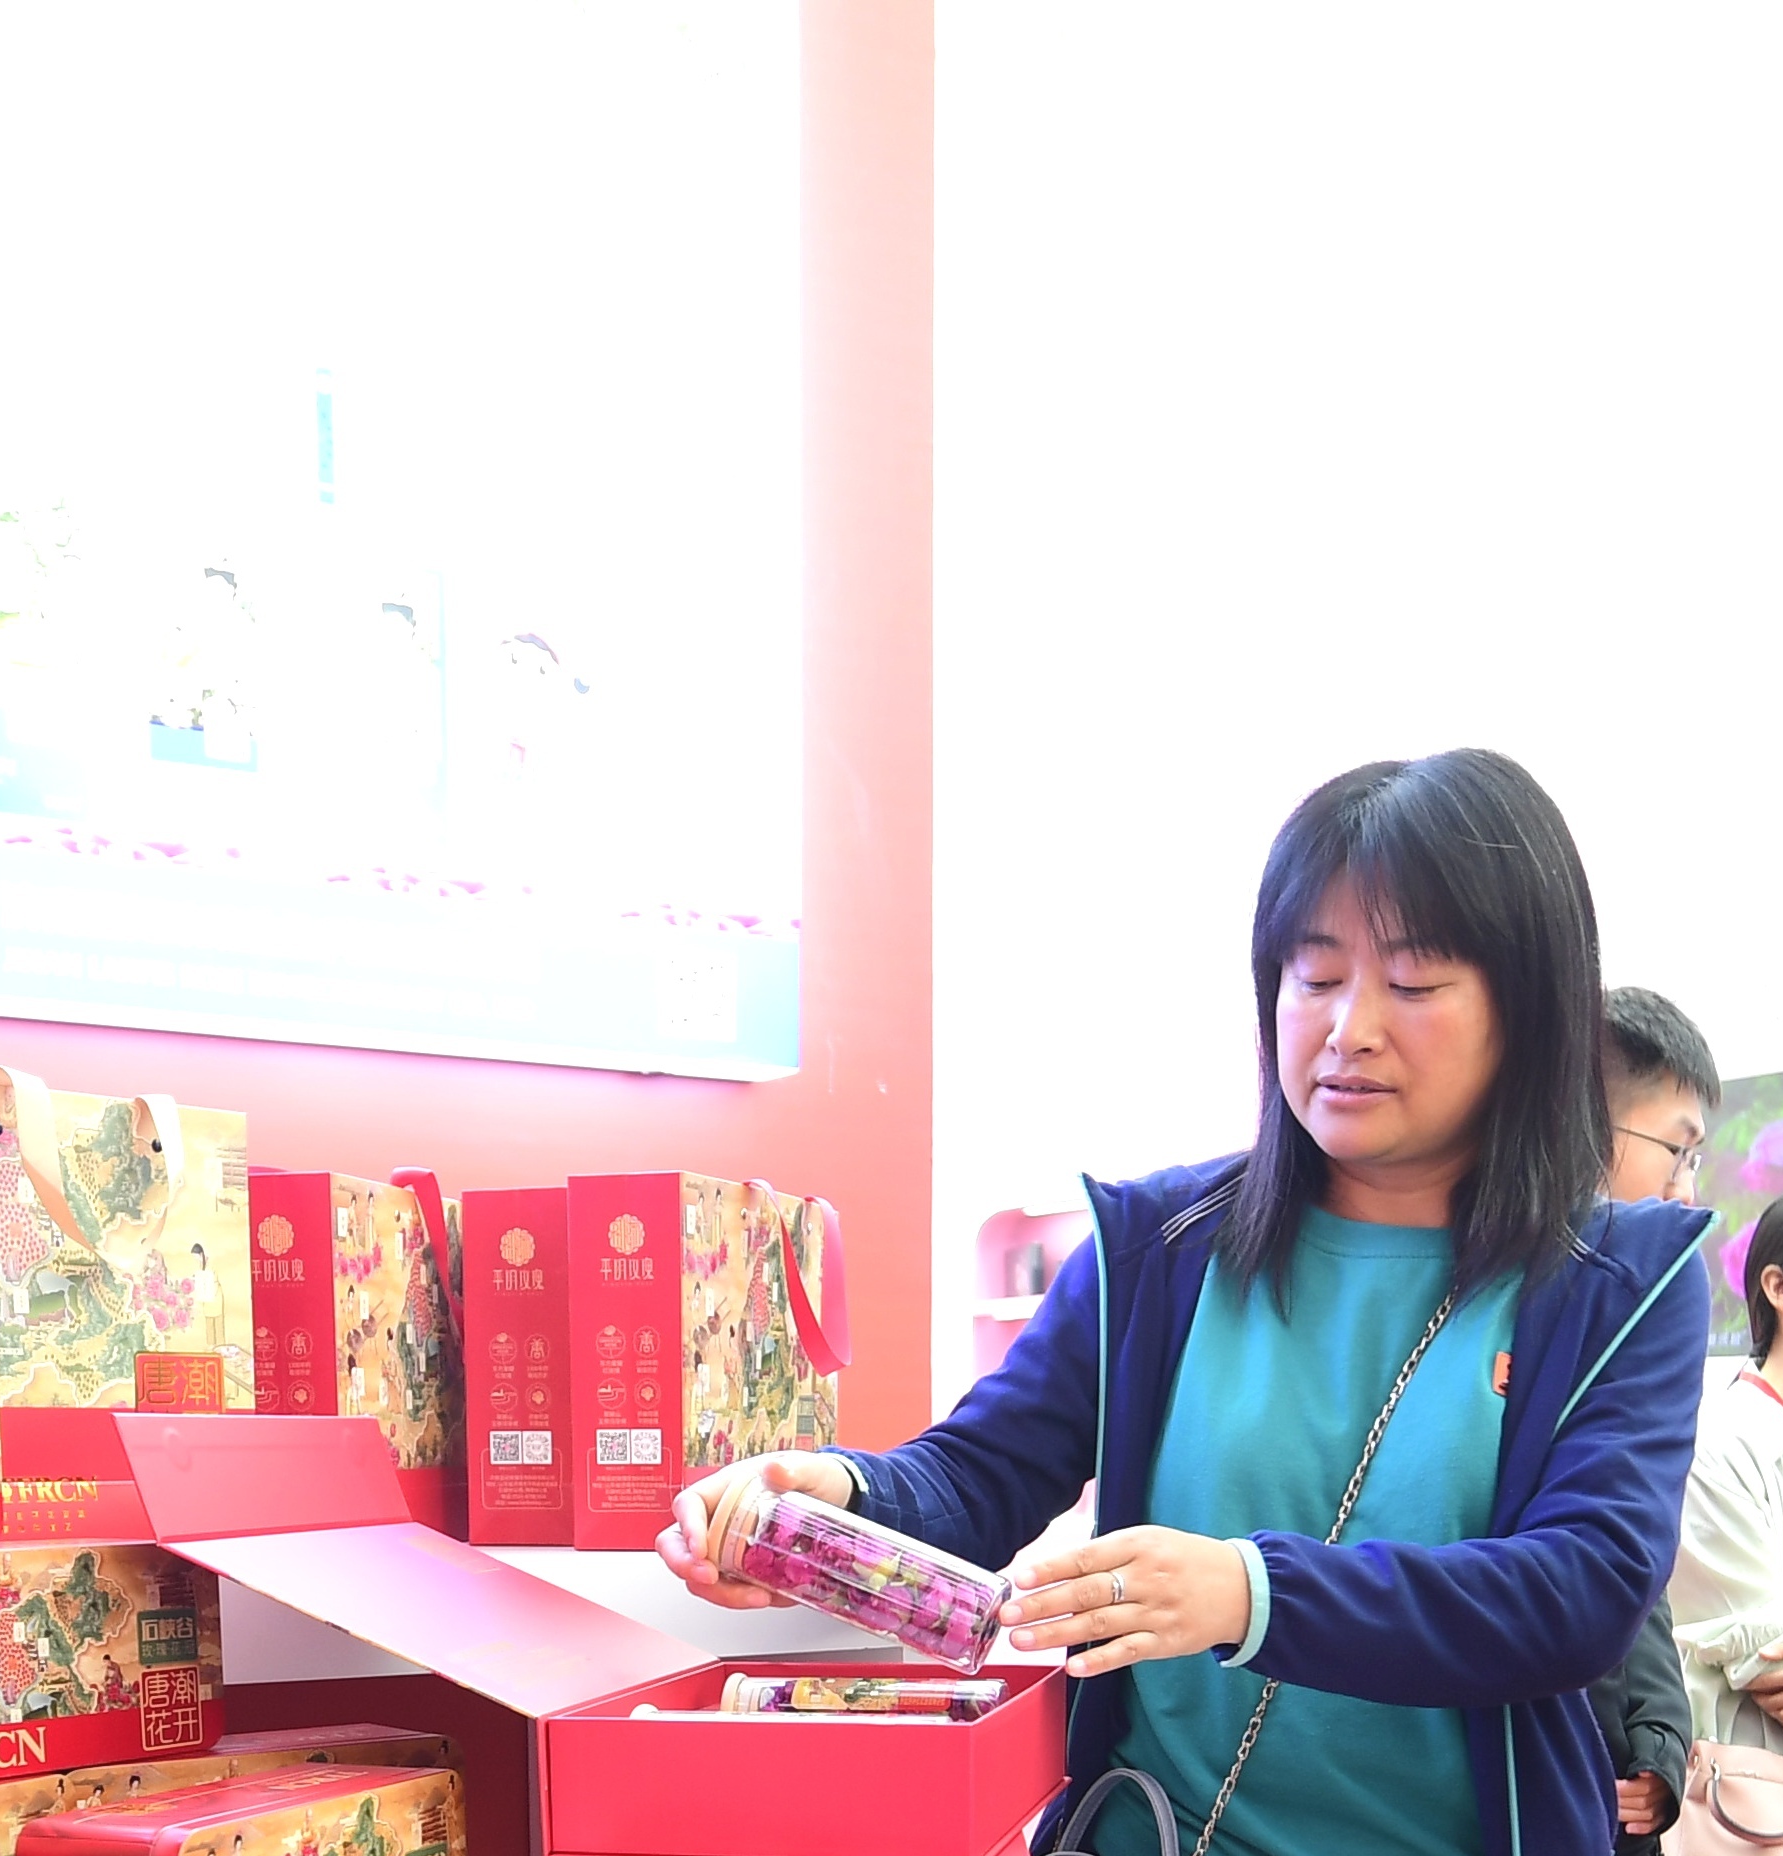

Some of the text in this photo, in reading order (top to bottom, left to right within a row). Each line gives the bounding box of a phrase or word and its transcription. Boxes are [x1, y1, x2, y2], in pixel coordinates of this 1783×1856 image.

[139, 1357, 219, 1405] 唐潮
[141, 1617, 193, 1641] 石峡谷
[144, 1671, 197, 1708] 唐潮
[146, 1707, 198, 1746] 花开
